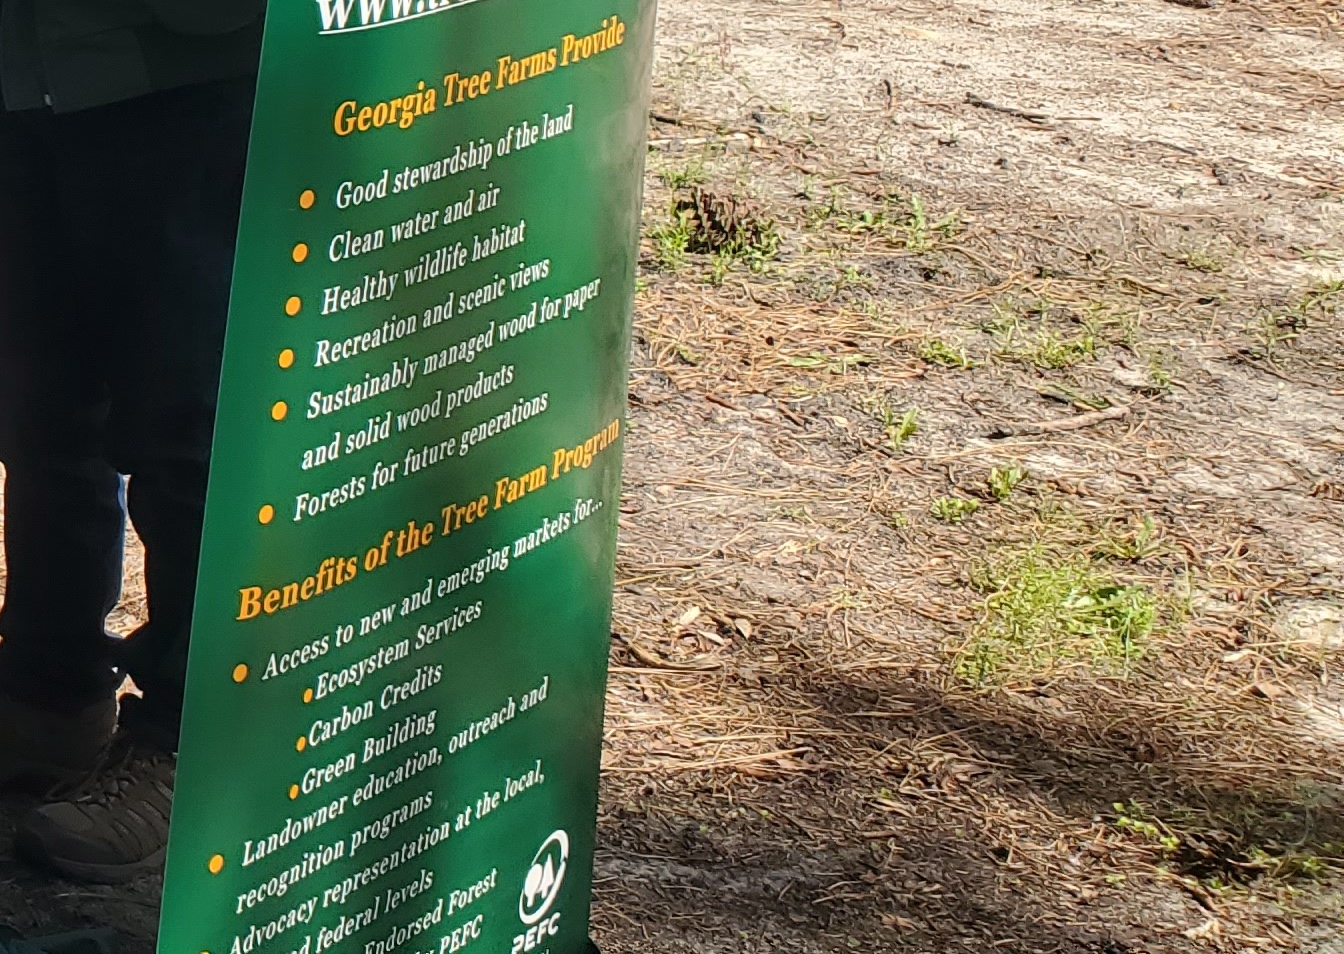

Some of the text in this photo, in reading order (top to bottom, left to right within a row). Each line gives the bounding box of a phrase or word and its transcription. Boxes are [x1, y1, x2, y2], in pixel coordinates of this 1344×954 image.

[333, 15, 625, 136] Georgia Tree Farms Provide
[336, 104, 574, 209] Good stewardship of the land
[320, 219, 527, 315] Healthy wildlife habitat
[328, 183, 501, 262] Clean water and air
[306, 277, 602, 420] Sustainably managed wood for paper
[314, 258, 551, 367] Recreation and scenic views
[292, 391, 549, 522] Forests for future generations
[301, 362, 515, 471] and solid wood products
[235, 554, 357, 621] Benefits
[364, 530, 396, 572] of
[395, 519, 434, 558] the
[440, 493, 489, 537] Tree
[492, 464, 549, 510] Farm
[261, 496, 604, 680] Access to new and emerging markets for...
[314, 599, 483, 701] Ecosystem Services
[301, 709, 438, 796] Green Building
[308, 662, 443, 746] Carbon Credits
[241, 675, 549, 868] Landowner education, outreach and
[229, 896, 319, 954] Advocacy
[322, 820, 450, 909] representation
[455, 804, 473, 833] at
[475, 788, 501, 820] the
[504, 758, 546, 802] local,
[236, 789, 434, 915] recognition programs
[315, 895, 380, 954] federal
[383, 868, 434, 914] levels
[364, 898, 444, 954] Endorsed
[447, 867, 498, 916] Forest
[439, 913, 484, 954] PEFC
[511, 911, 562, 954] PEFC
